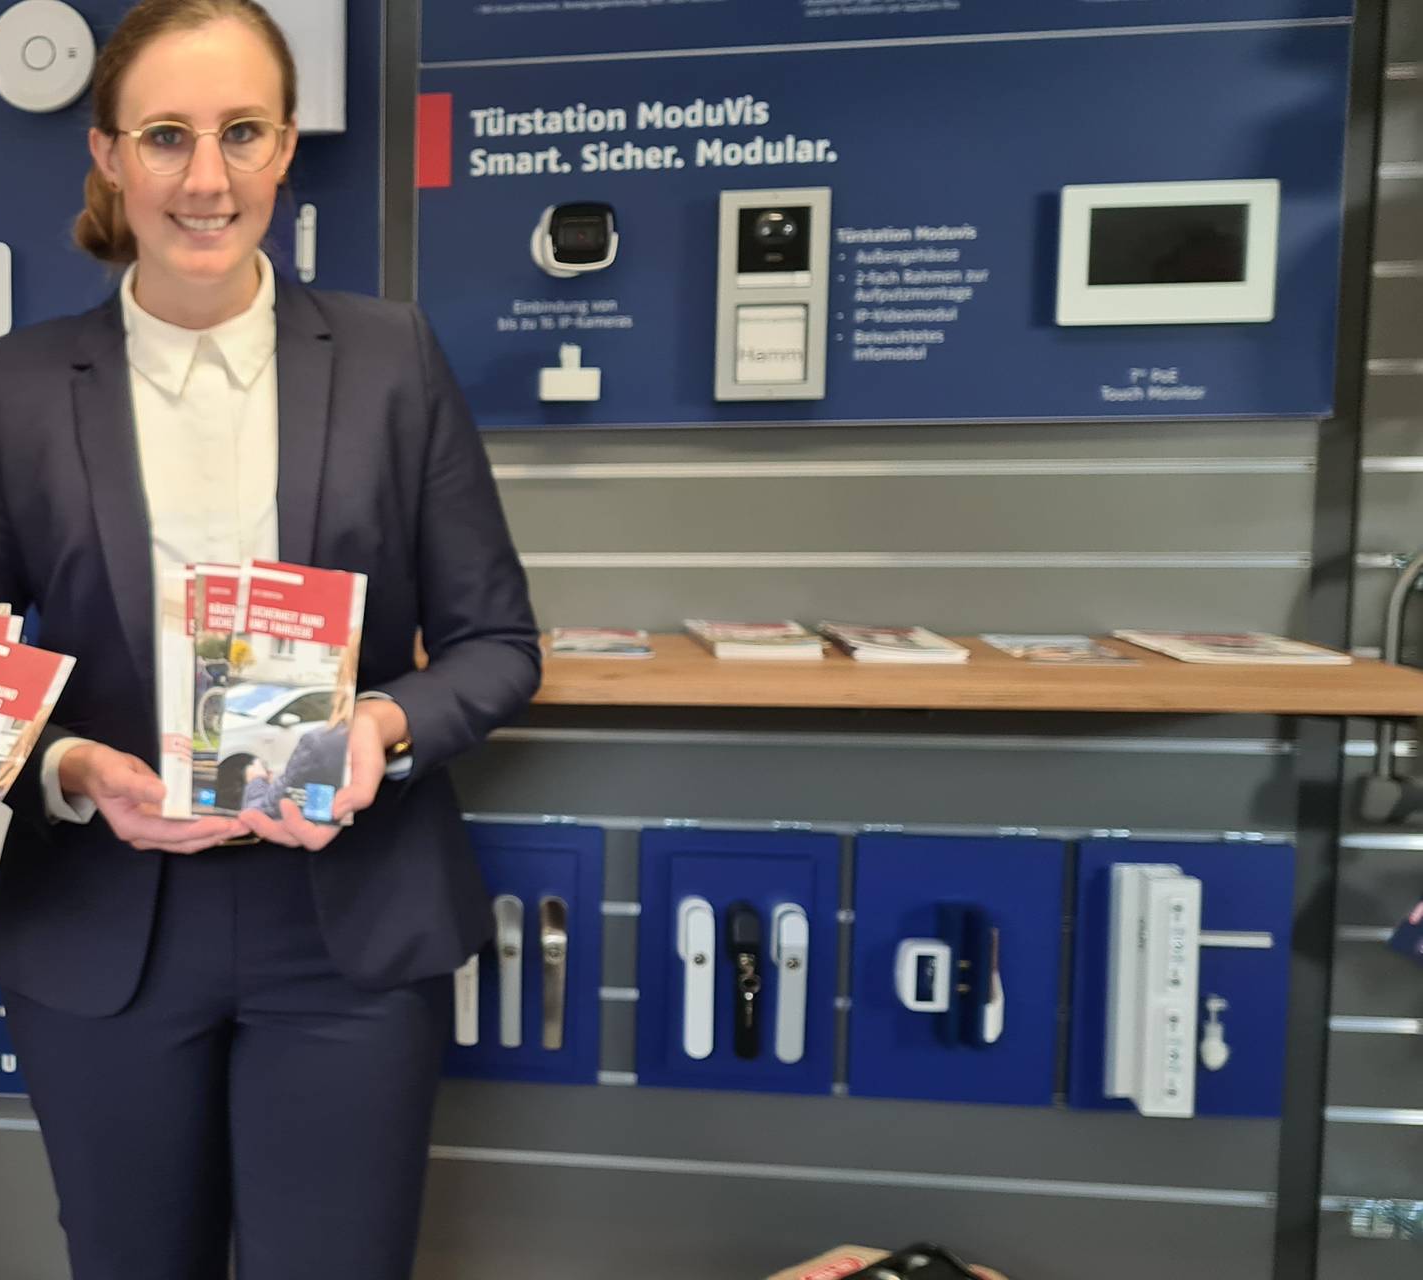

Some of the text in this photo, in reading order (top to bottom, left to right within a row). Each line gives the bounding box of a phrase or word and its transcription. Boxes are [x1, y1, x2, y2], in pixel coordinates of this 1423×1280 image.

[470, 95, 769, 137] Türstation ModuVis
[470, 135, 838, 177] Smart. Sicher. Modular.
[835, 226, 912, 243] Türstation
